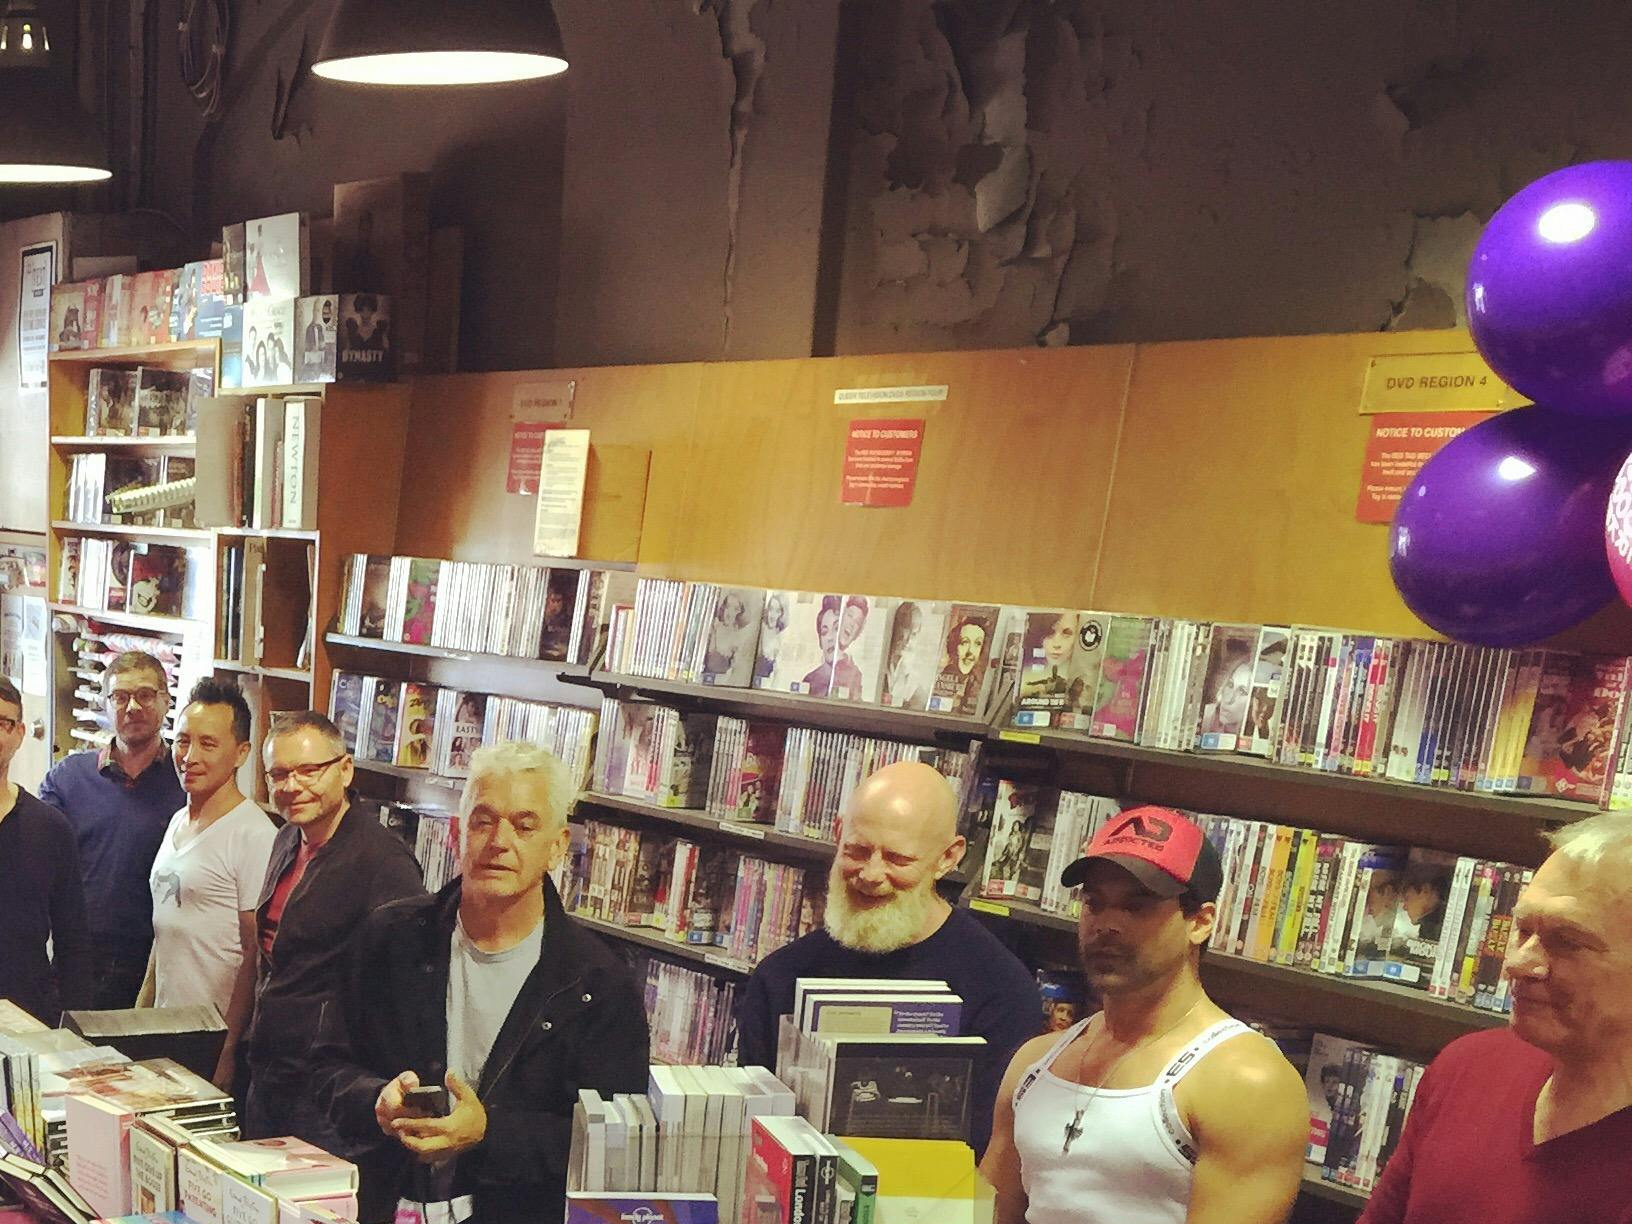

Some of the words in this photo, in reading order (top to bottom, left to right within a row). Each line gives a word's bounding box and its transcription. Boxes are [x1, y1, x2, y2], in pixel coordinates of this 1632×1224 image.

[1386, 377, 1414, 389] DVD
[1419, 375, 1475, 388] REGION
[1480, 376, 1487, 386] 4
[1376, 427, 1408, 438] NOTICE
[1411, 428, 1422, 437] TO
[287, 413, 302, 508] NEWTON
